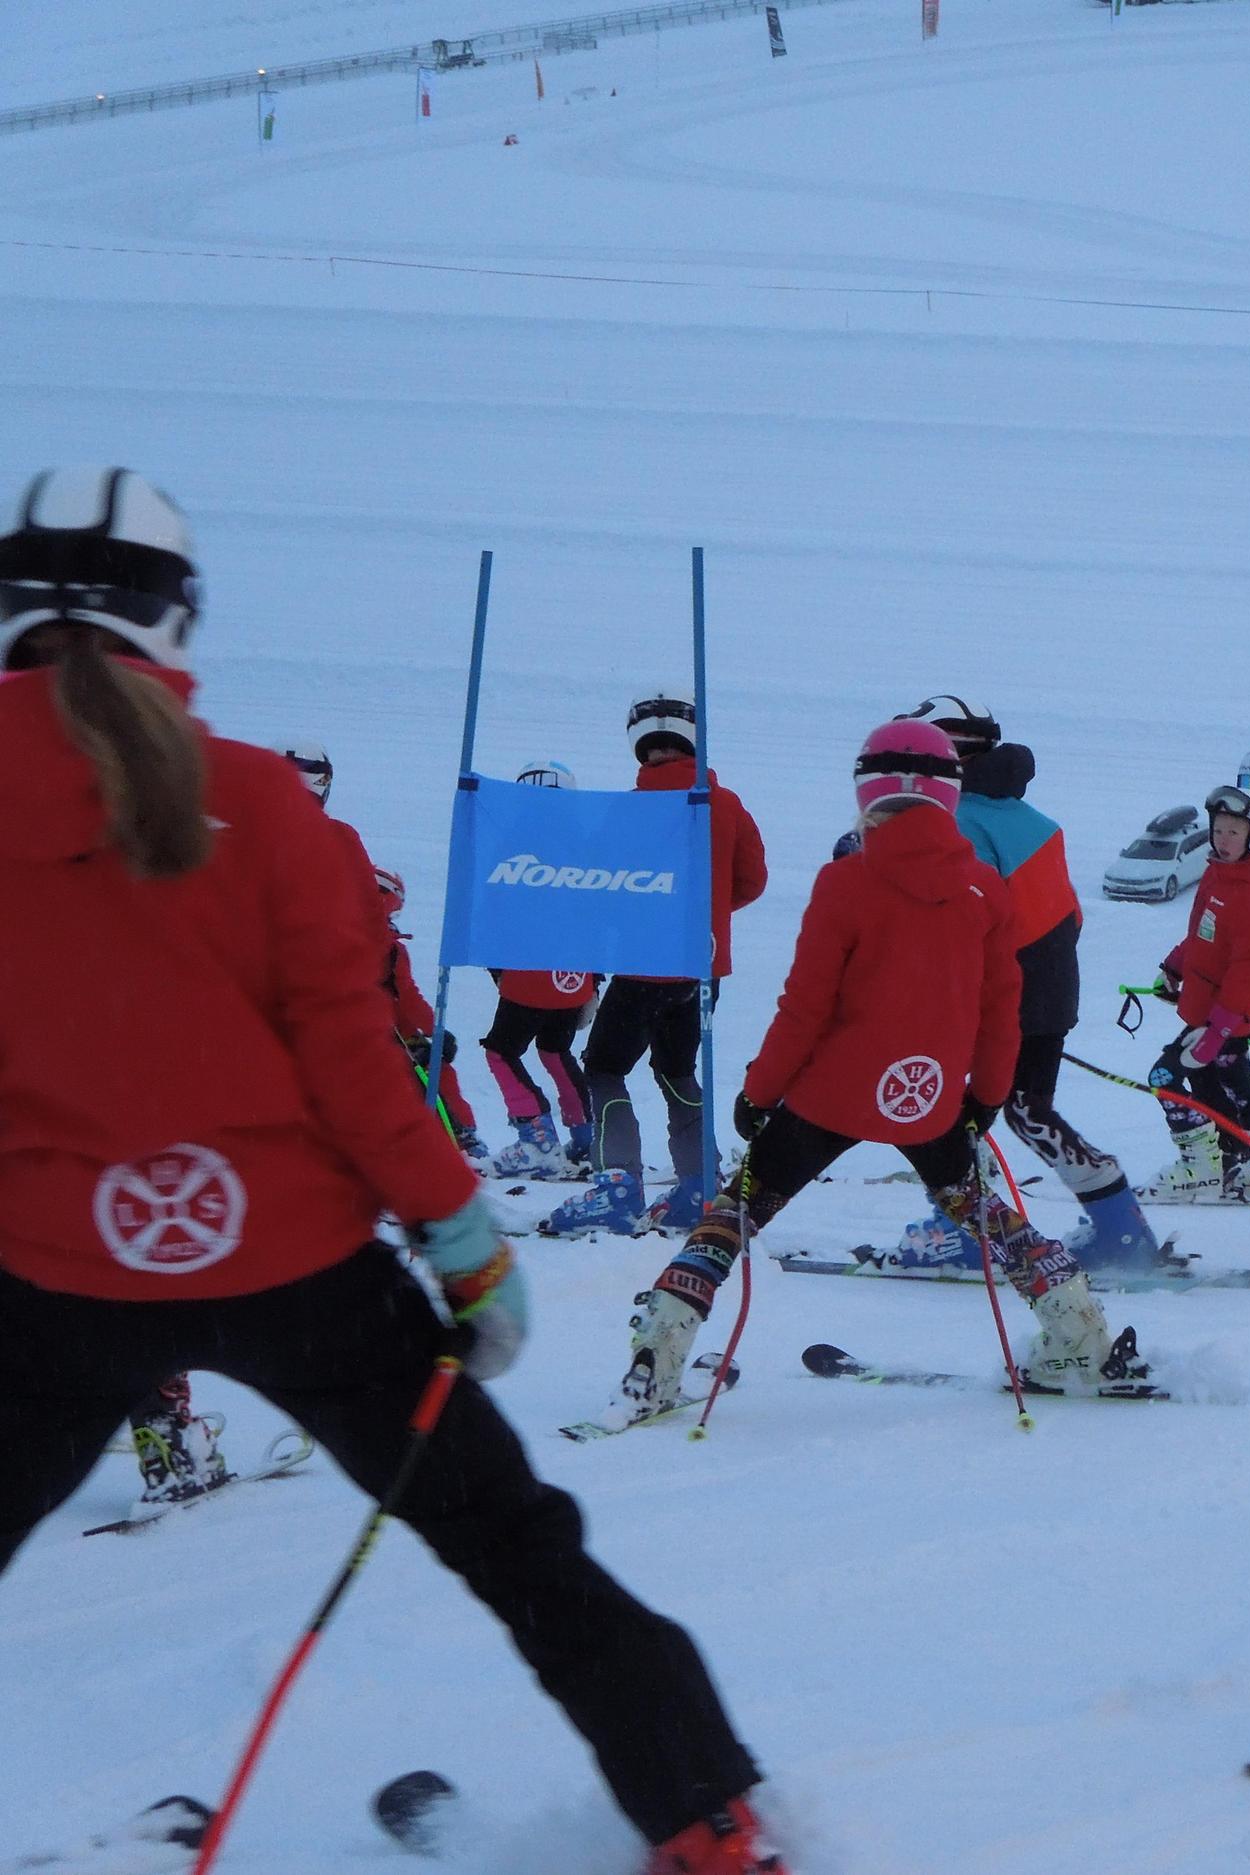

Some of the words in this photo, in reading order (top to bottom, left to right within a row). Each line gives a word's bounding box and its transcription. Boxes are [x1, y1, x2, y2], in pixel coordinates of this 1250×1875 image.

[487, 854, 675, 894] NORDICA
[909, 1065, 923, 1079] H
[888, 1083, 899, 1096] L
[925, 1083, 935, 1096] S
[1173, 1178, 1220, 1191] HEAD
